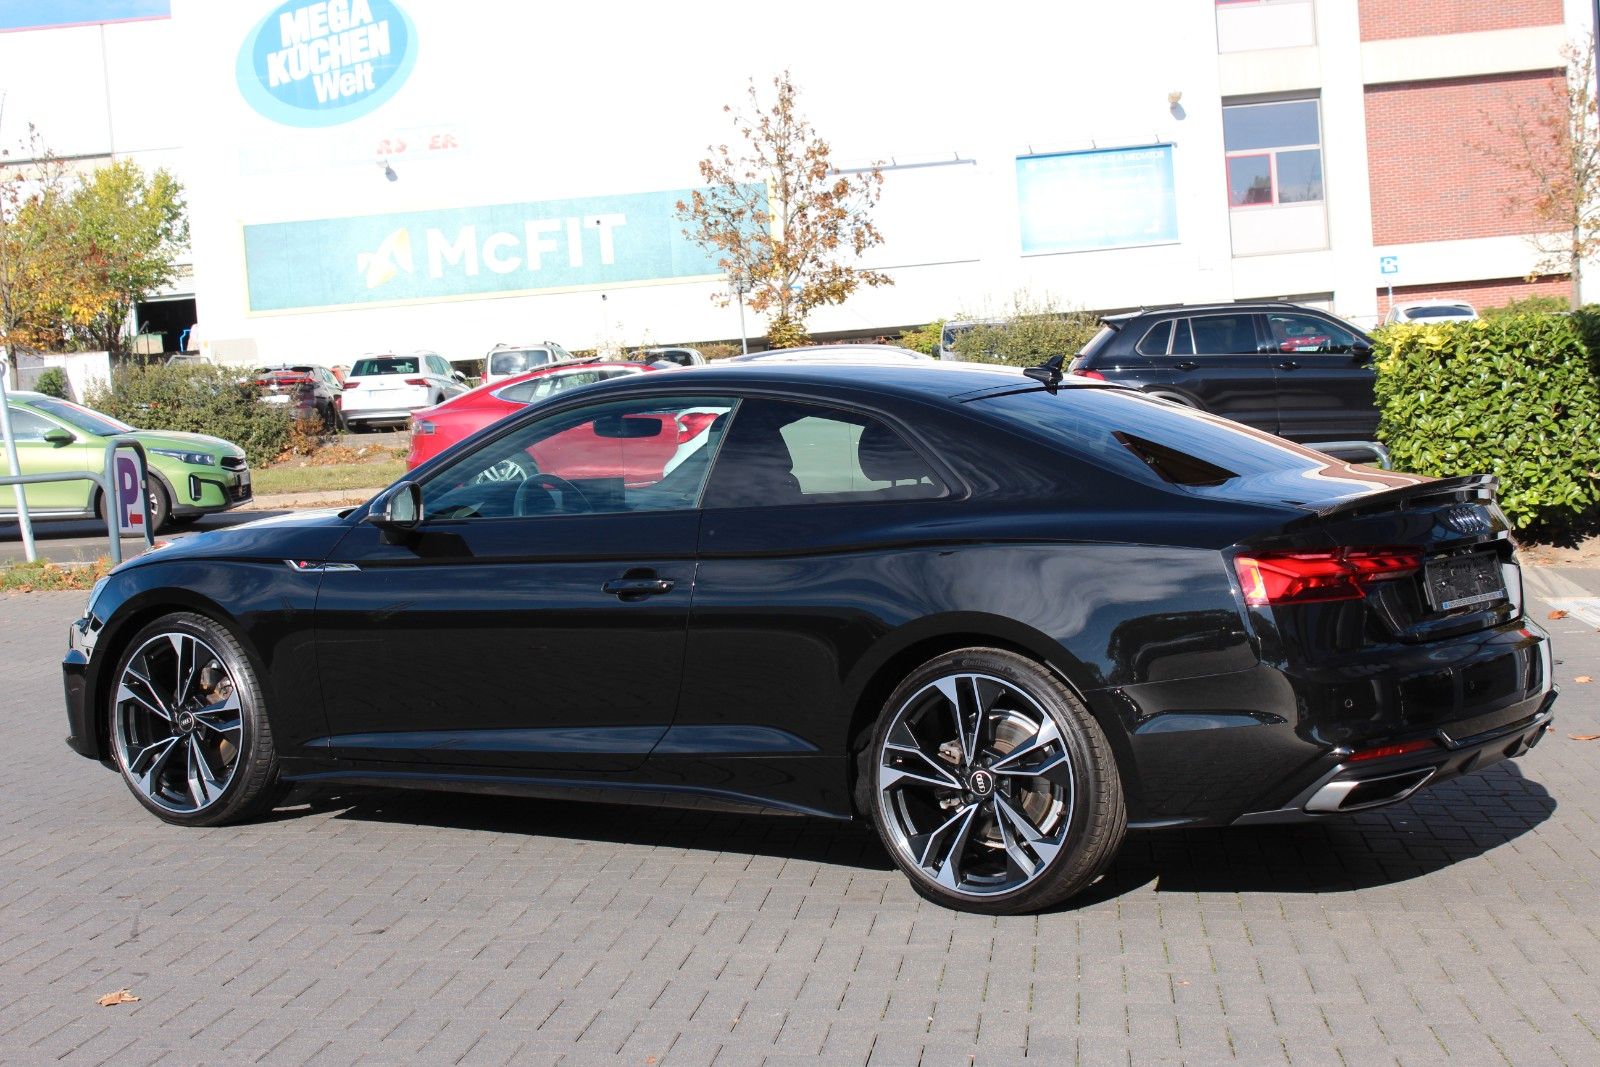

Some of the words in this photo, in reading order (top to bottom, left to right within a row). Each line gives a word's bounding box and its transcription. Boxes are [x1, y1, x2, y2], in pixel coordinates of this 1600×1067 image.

[279, 0, 373, 47] MEGA
[312, 62, 376, 104] Welt
[116, 457, 139, 528] P
